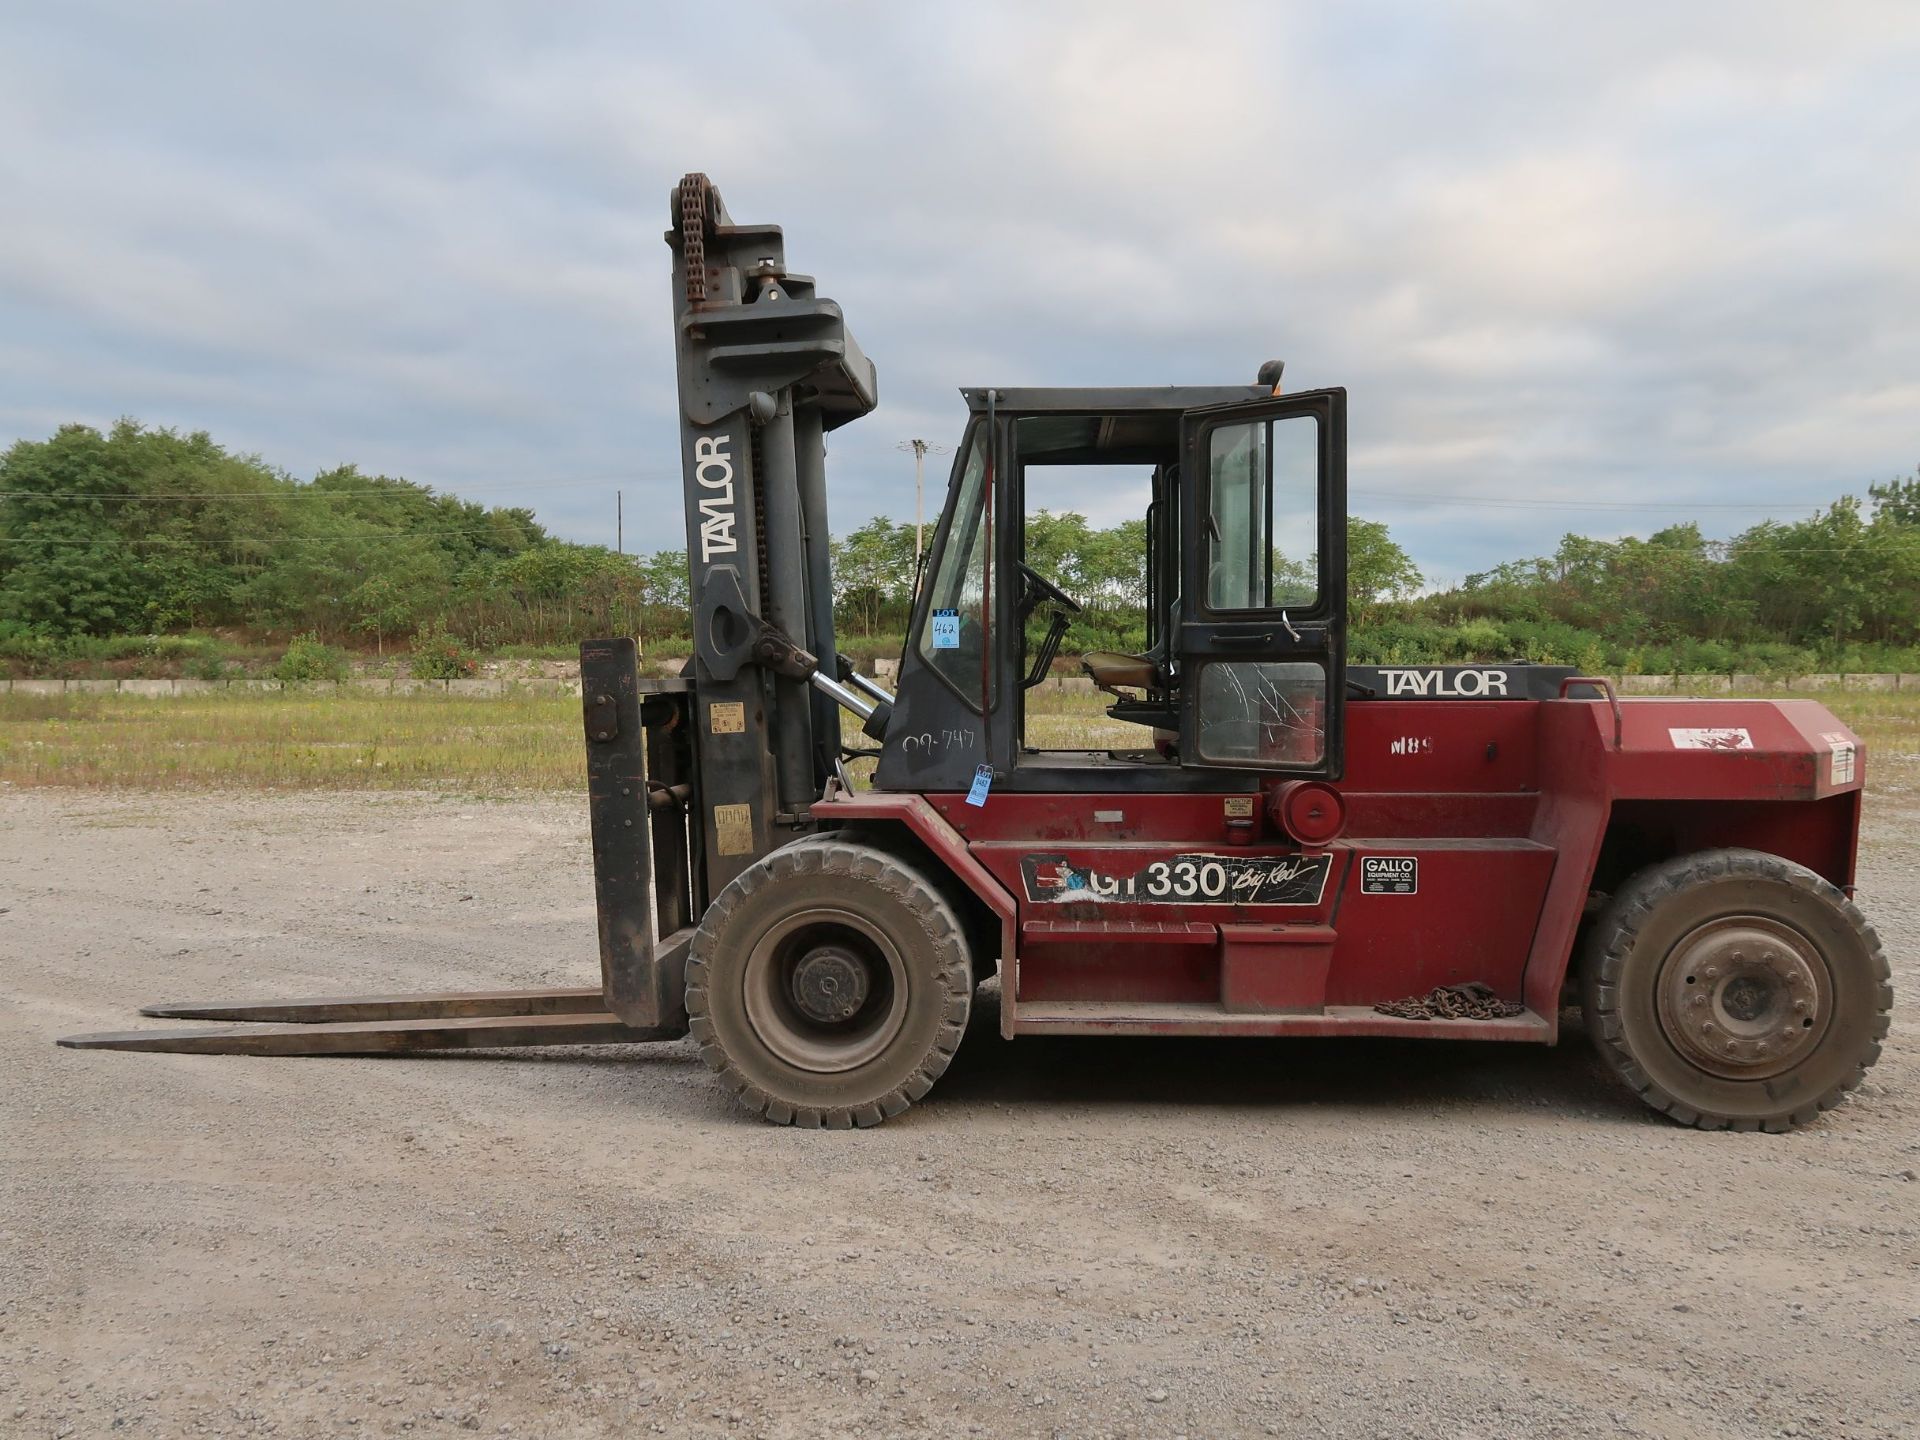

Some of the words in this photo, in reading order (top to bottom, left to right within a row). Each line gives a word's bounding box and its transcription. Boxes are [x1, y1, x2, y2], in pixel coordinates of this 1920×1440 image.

[695, 434, 738, 563] TAYLOR
[936, 609, 956, 617] LOT
[934, 621, 957, 635] 462
[1377, 669, 1508, 696] TAYLOR
[977, 769, 992, 778] LOT
[1366, 860, 1413, 872] GALLO
[1147, 862, 1226, 896] 330
